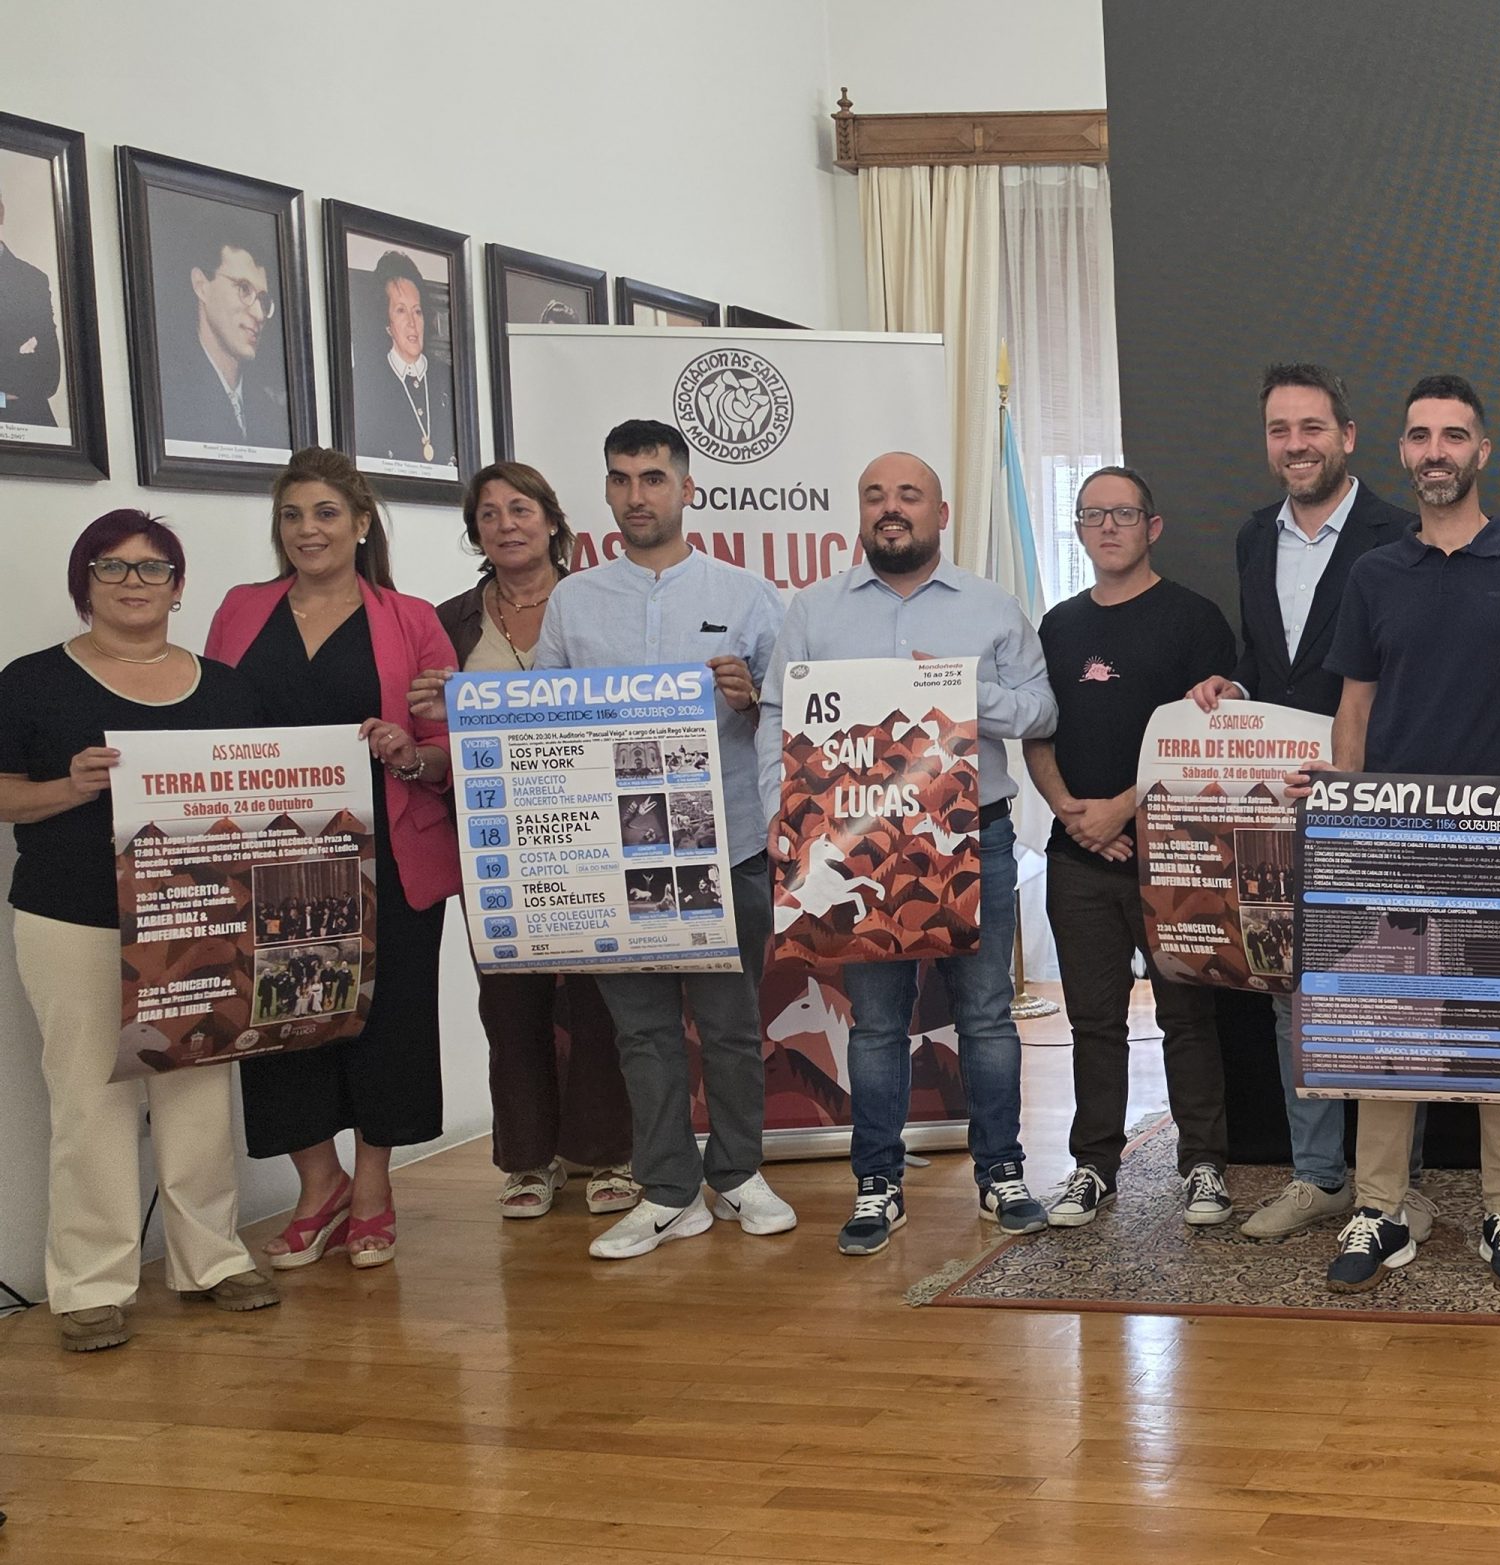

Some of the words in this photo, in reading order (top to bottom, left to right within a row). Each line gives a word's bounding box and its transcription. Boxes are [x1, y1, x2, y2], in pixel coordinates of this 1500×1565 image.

[751, 360, 779, 387] SAN
[689, 482, 829, 511] OCIACIÓN
[457, 680, 501, 711] AS
[506, 676, 578, 708] SAN
[584, 671, 702, 705] LUCAS
[913, 680, 941, 688] Outono
[942, 678, 962, 687] 2026
[460, 711, 545, 726] MONDOÑEDO
[548, 709, 593, 723] DENDE
[678, 705, 704, 717] 2026
[805, 691, 841, 725] AS
[1209, 714, 1222, 730] AS
[212, 744, 227, 760] AS
[472, 751, 495, 769] 16
[509, 748, 532, 759] LOS
[535, 745, 585, 758] PLAYERS
[822, 736, 875, 772] SAN
[1157, 738, 1201, 758] TERRA
[1205, 738, 1224, 758] DE
[1227, 739, 1321, 759] ENCONTROS
[510, 759, 539, 771] NEW
[543, 758, 575, 769] YORK
[1182, 766, 1222, 780] Sábado,
[1223, 767, 1235, 779] 24
[1236, 767, 1248, 779] de
[1249, 767, 1288, 779] Outubro
[142, 773, 206, 795] TERRA
[210, 771, 233, 791] DE
[238, 765, 345, 790] ENCONTROS
[513, 785, 565, 796] MARBELLA
[475, 789, 497, 808] 17
[512, 774, 567, 786] SUAVECITO
[513, 795, 558, 807] CONCERTO
[559, 794, 575, 805] THE
[576, 792, 613, 804] RAPANTS
[834, 783, 920, 819] LUCAS
[1305, 780, 1350, 811] AS
[1353, 782, 1422, 814] SAN
[183, 801, 232, 817] Sábado,
[234, 801, 248, 813] 24
[251, 800, 266, 812] de
[268, 798, 313, 811] Outubro
[480, 828, 501, 847] 18
[515, 811, 600, 825] SALSARENA
[516, 823, 592, 835] PRINCIPAL
[1306, 814, 1387, 827] MONDOÑEDO
[1389, 817, 1433, 829] DENDE
[1436, 818, 1457, 830] 1156
[486, 864, 502, 878] 19
[519, 852, 557, 864] COSTA
[560, 849, 610, 861] DORADA
[520, 864, 570, 877] CAPITOL
[167, 884, 219, 899] CONCERTO
[486, 896, 507, 909] 20
[522, 881, 567, 895] TRÉBOL
[524, 896, 546, 908] LOS
[549, 892, 606, 906] SATÉLITES
[491, 924, 512, 938] 23
[526, 913, 547, 924] LOS
[550, 908, 617, 922] COLEGUITAS
[528, 923, 543, 934] DE
[545, 919, 610, 932] VENEZUELA
[168, 976, 221, 993] CONCERTO
